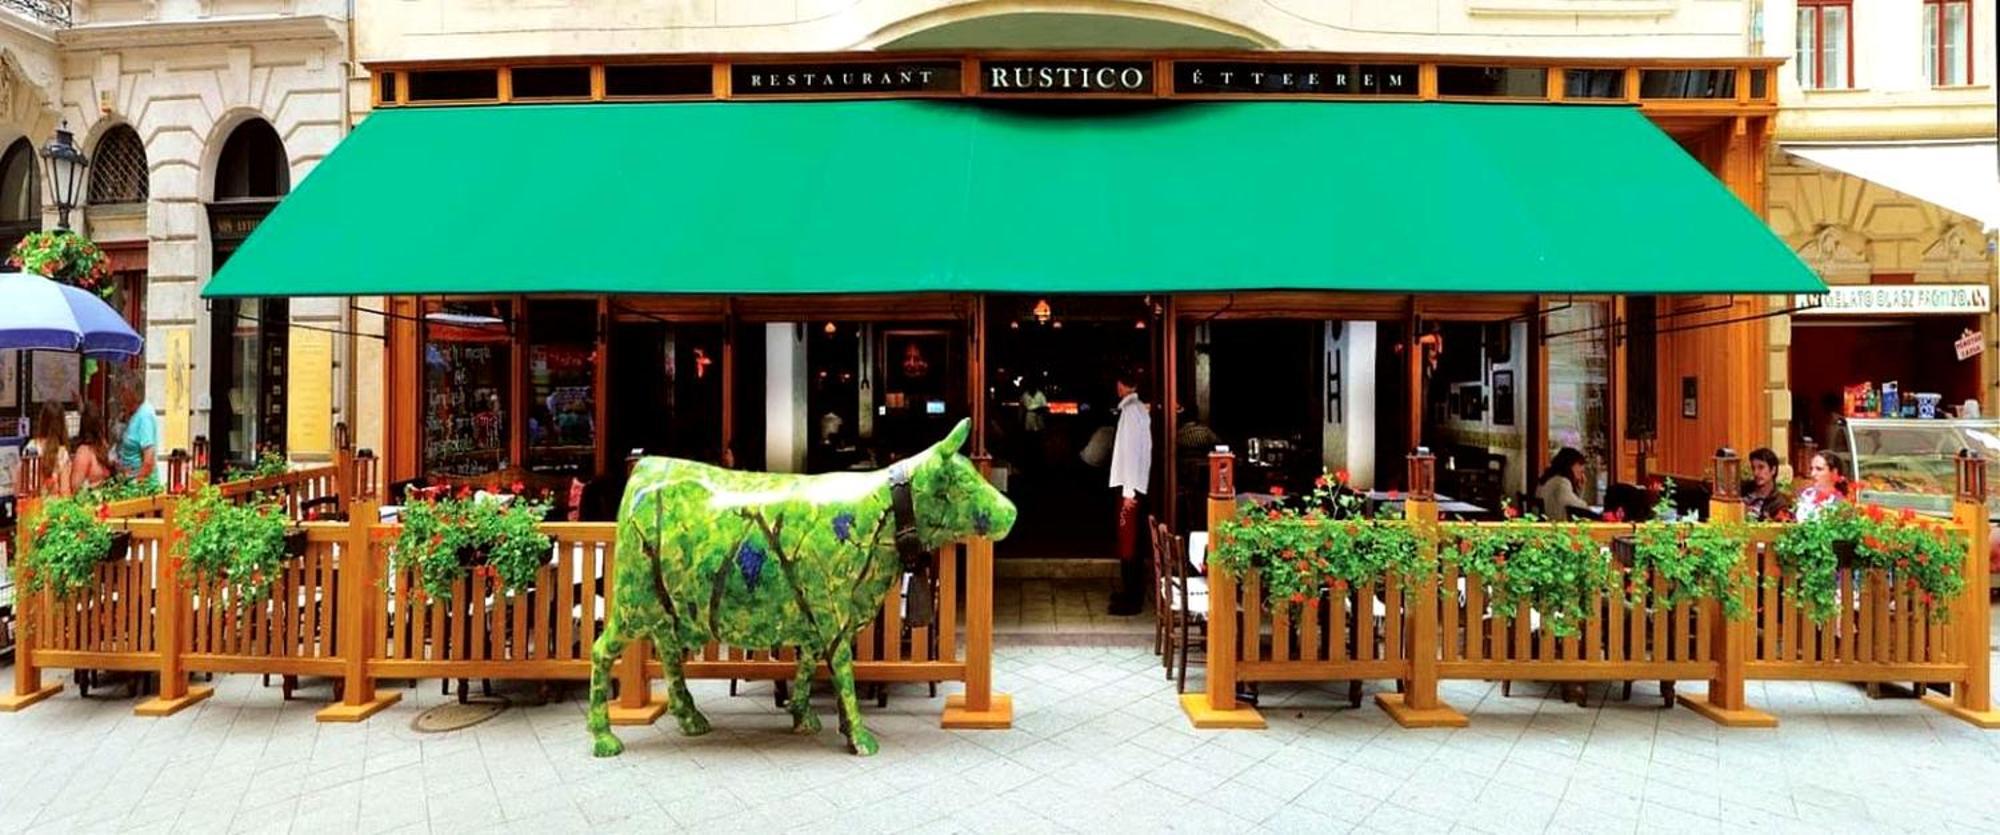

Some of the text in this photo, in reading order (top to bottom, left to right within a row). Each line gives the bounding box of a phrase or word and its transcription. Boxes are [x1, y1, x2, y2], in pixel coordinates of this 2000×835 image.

[751, 71, 933, 87] RESTAURANT
[991, 67, 1144, 89] RUSTICO
[1192, 69, 1403, 87] ÉTTEEREM
